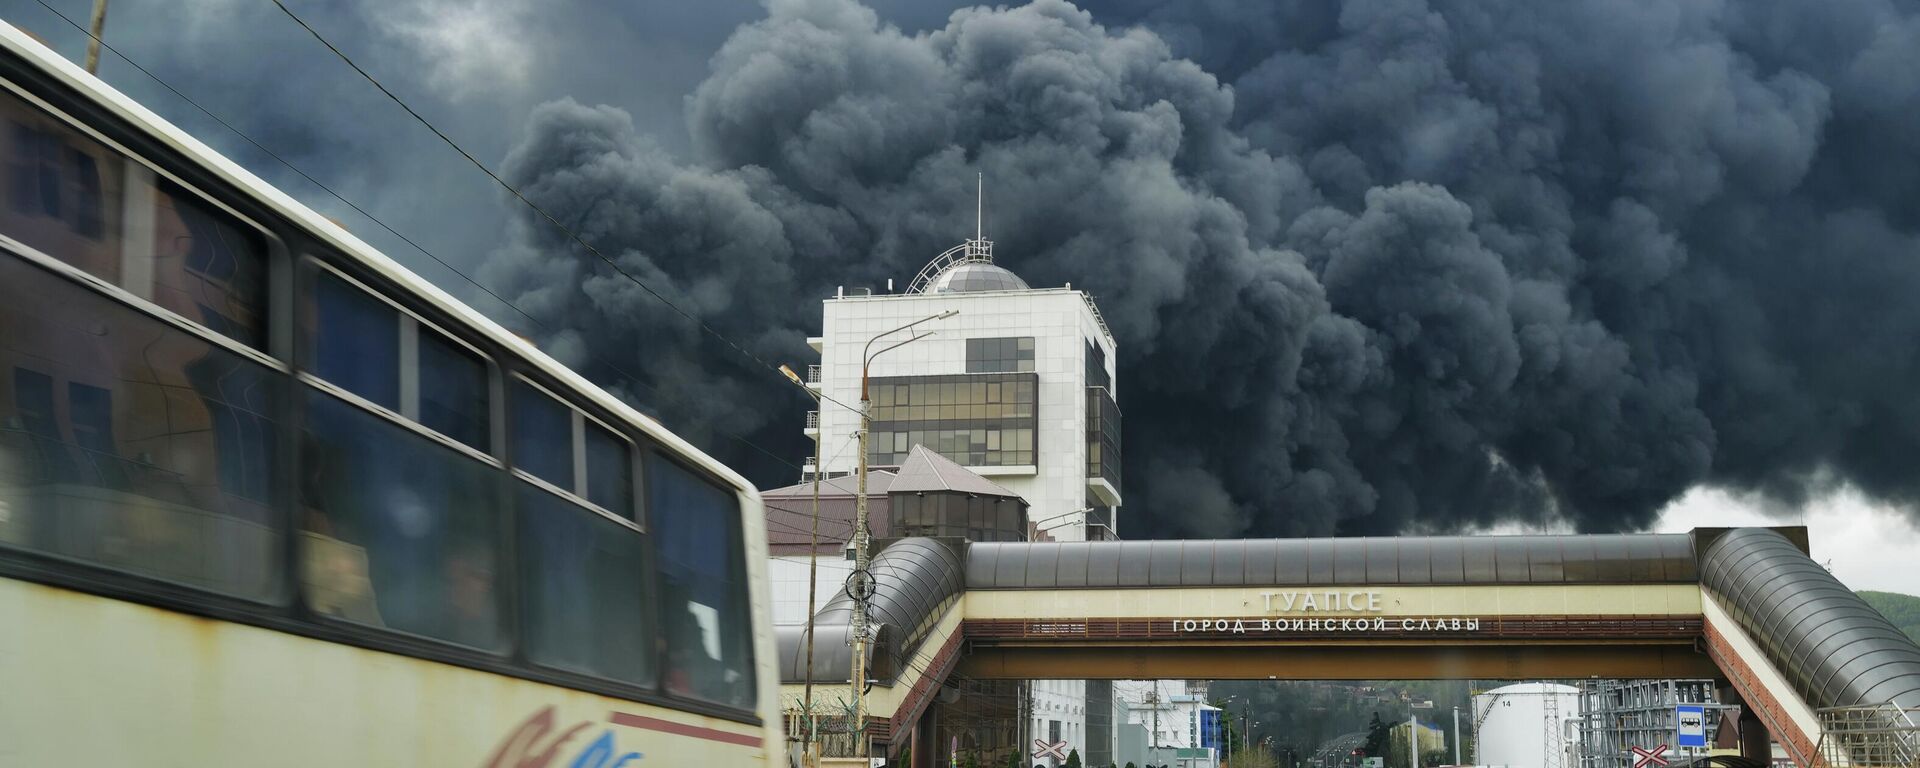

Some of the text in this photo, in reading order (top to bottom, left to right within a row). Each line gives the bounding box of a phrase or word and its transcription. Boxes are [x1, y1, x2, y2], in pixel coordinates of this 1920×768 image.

[1260, 591, 1382, 612] ТУАПСЕ
[1173, 617, 1479, 633] ГОРОД ВОИНСКОЙ СЛАВЫ
